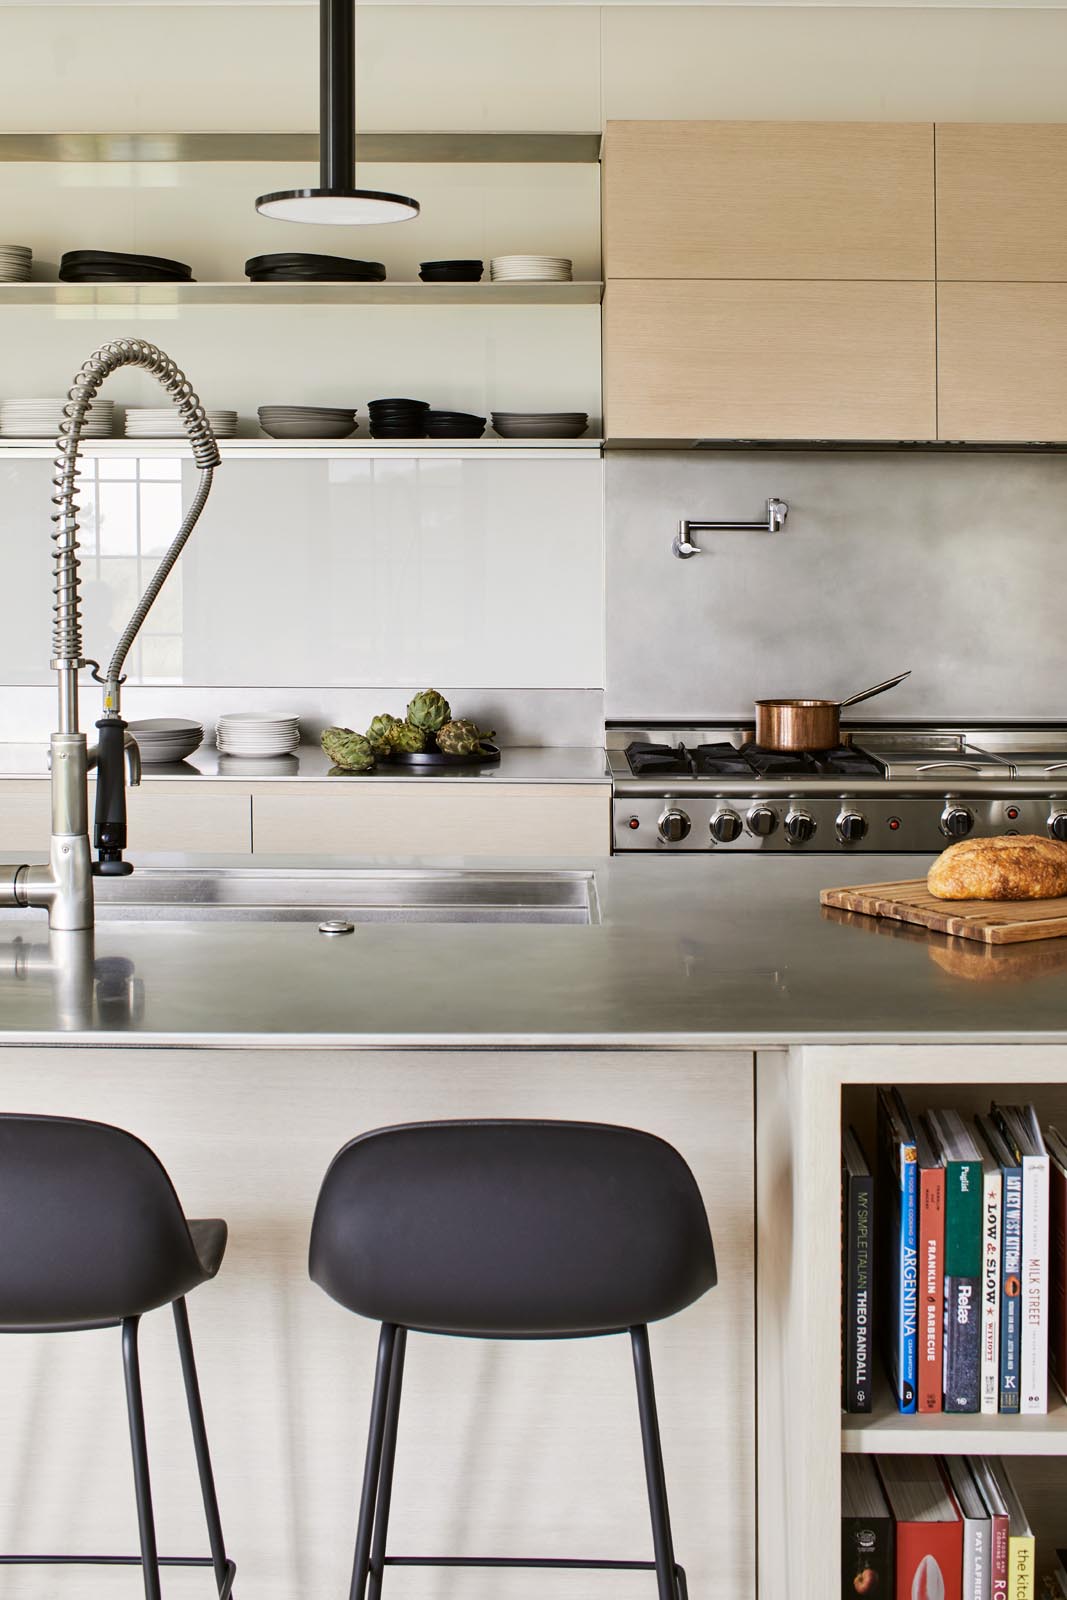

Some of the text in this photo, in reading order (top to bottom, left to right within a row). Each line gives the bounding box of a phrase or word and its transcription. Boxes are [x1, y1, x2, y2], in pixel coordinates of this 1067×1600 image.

[960, 1166, 969, 1192] Puglisi
[1006, 1192, 1020, 1209] KEY
[857, 1192, 868, 1289] MY SIMPLE ITALIAN
[1006, 1210, 1020, 1234] WEST
[927, 1240, 936, 1294] FRANKLIN
[985, 1204, 996, 1304] LOW & SLOW
[1006, 1236, 1019, 1272] KITCHEN
[1029, 1259, 1040, 1284] MILK
[856, 1291, 867, 1324] THEO
[904, 1246, 916, 1336] ARGENTINA
[1028, 1288, 1040, 1326] STREET
[927, 1305, 936, 1361] BARBECUE
[856, 1326, 867, 1384] RANDALL
[1004, 1376, 1016, 1388] K
[1016, 1550, 1029, 1600] the kitc
